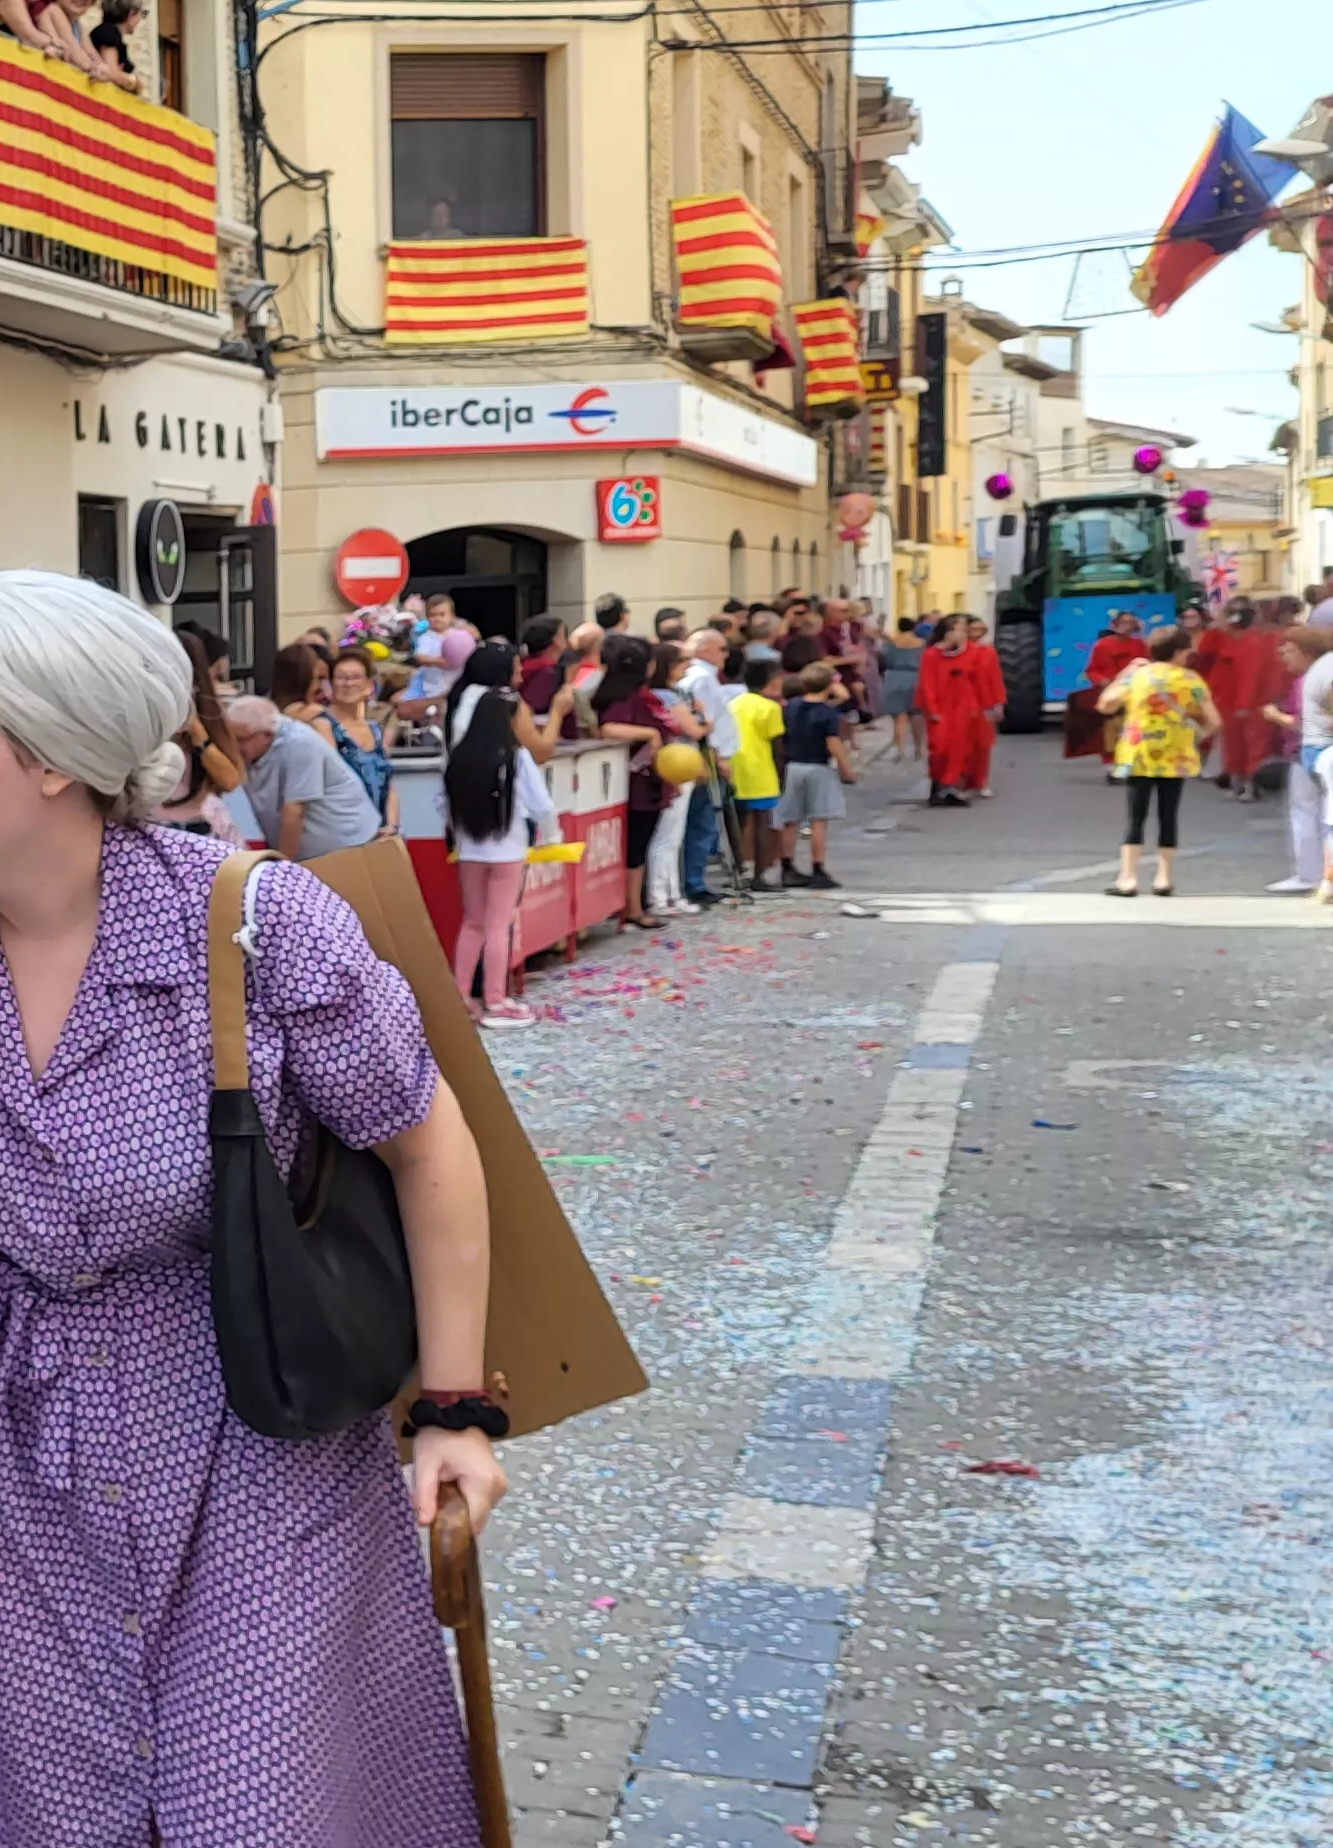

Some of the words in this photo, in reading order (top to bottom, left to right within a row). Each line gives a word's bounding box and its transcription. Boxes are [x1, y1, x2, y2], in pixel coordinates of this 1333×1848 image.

[74, 400, 111, 444] LA
[135, 411, 246, 461] GATERA
[389, 397, 534, 432] iberCaja
